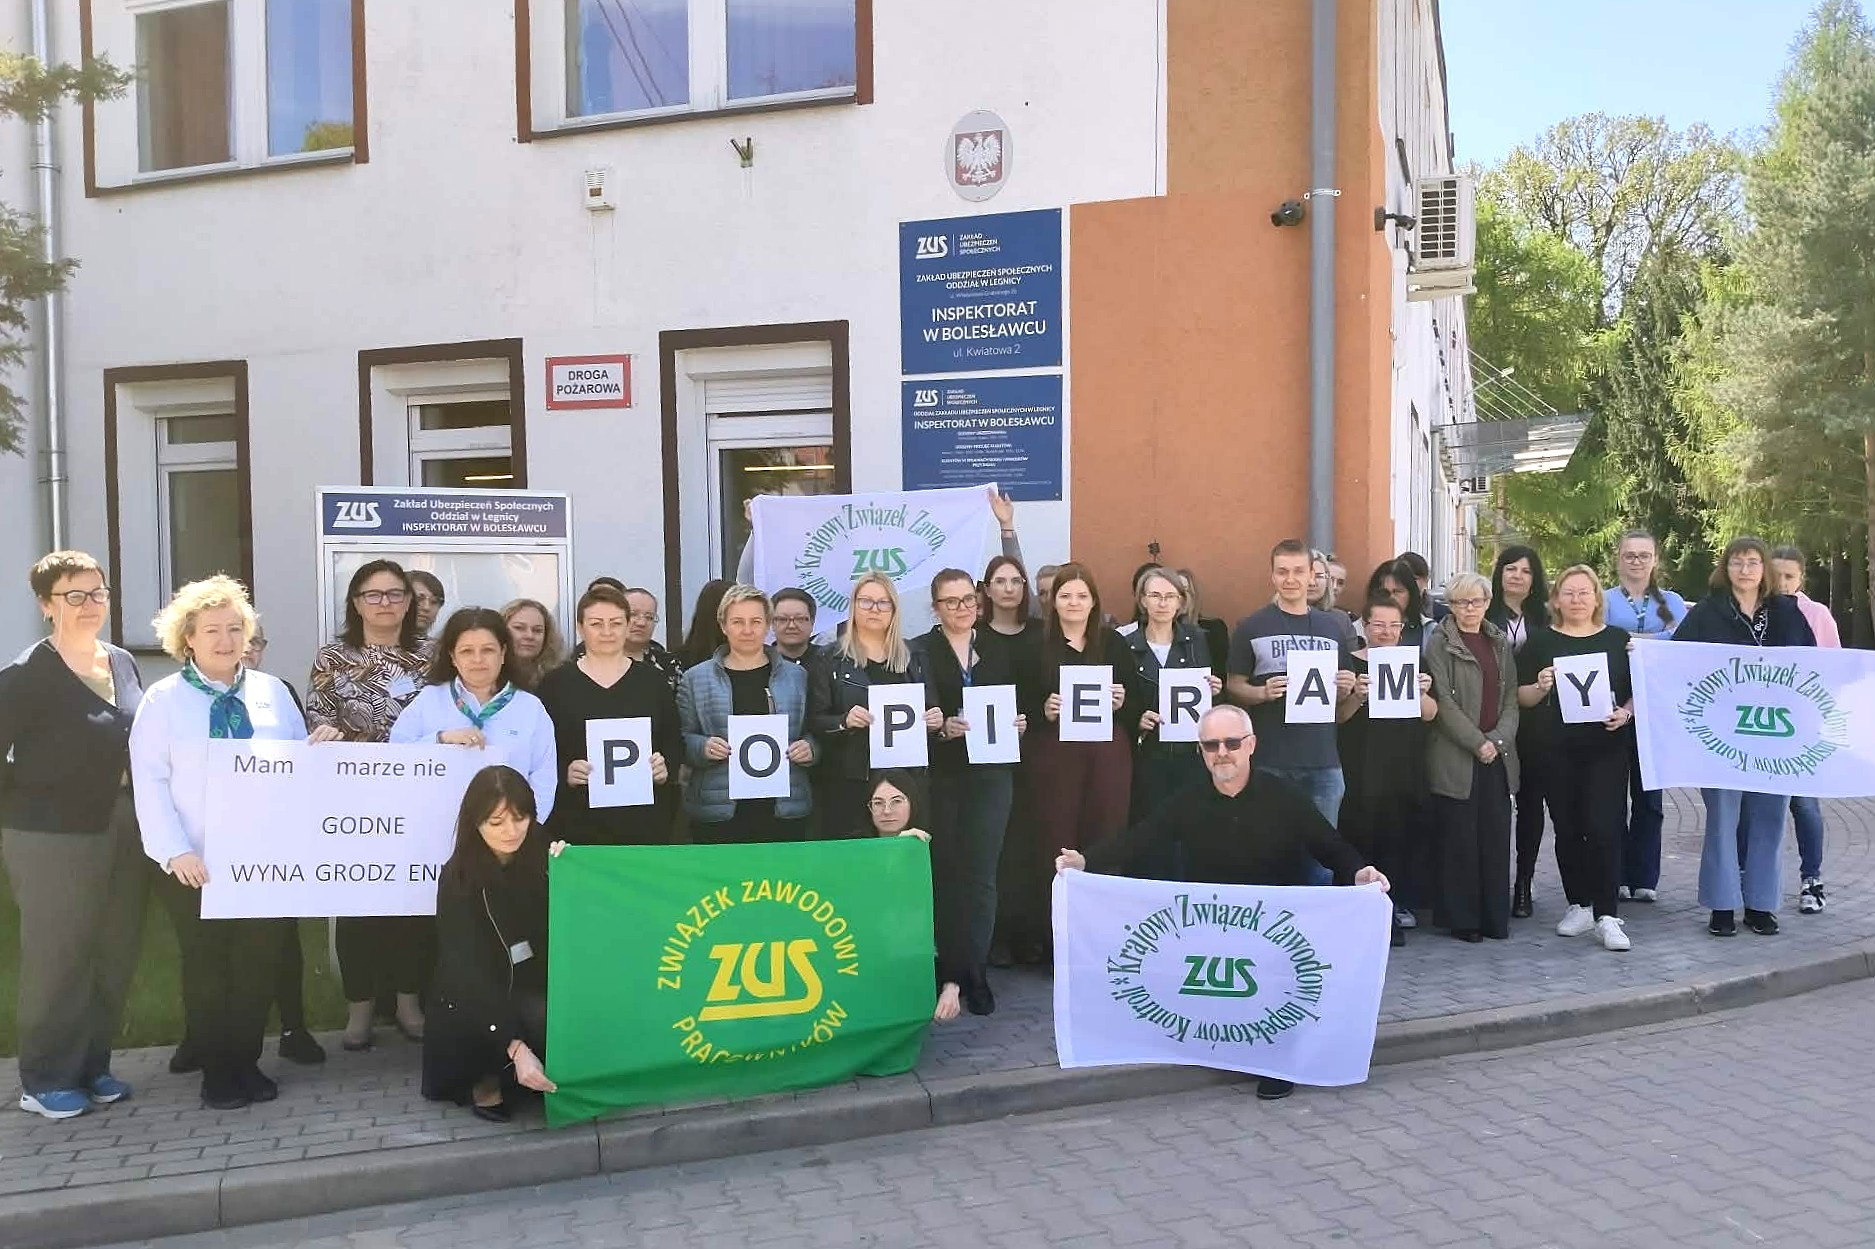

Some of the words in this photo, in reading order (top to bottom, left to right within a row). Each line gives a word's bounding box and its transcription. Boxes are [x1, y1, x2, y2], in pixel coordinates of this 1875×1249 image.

[916, 235, 948, 260] ZUS
[916, 273, 946, 282] ZAKŁAD
[946, 268, 996, 280] UBEZPIECZEŃ
[998, 264, 1052, 276] SPOŁECZNYCH
[946, 280, 980, 290] ODDZIAŁ
[980, 279, 989, 287] W
[990, 277, 1022, 286] LEGNICY
[932, 301, 1037, 322] INSPEKTORAT
[922, 328, 940, 342] W
[942, 320, 1046, 340] BOLESŁAWCU
[966, 346, 1012, 357] Kwiatowa
[1014, 344, 1022, 354] 2
[556, 382, 620, 395] POŻAROWA
[568, 370, 609, 380] DROGA
[914, 389, 938, 406] ZUS
[914, 419, 977, 430] INSPEKTORAT
[978, 418, 989, 428] W
[990, 416, 1054, 428] BOLESŁAWCU
[332, 501, 382, 528] ZUS
[394, 499, 427, 510] Zakład
[430, 500, 492, 510] Ubezpieczeń
[494, 500, 554, 512] Społecznych
[430, 511, 469, 521] Oddział
[482, 512, 519, 524] Legnicy
[842, 501, 907, 531] Związek
[402, 522, 468, 532] INSPEKTORAT
[470, 524, 481, 532] W
[483, 524, 547, 533] BOLESŁAWCU
[794, 514, 848, 570] Krajowy
[908, 510, 946, 548] Zawo
[850, 548, 908, 580] ZUS
[799, 576, 850, 612] ontroli
[1729, 656, 1800, 688] Związek
[1677, 667, 1733, 718] Krajowy
[602, 738, 640, 786] P
[738, 733, 782, 778] O
[883, 704, 916, 748] P
[986, 704, 997, 744] I
[1072, 683, 1102, 723] E
[1170, 685, 1200, 724] R
[1294, 668, 1330, 706] A
[1377, 663, 1416, 701] M
[1564, 670, 1600, 708] Y
[1734, 705, 1796, 738] ZUS
[1685, 725, 1748, 772] Kontroli
[1754, 740, 1850, 780] Inspektorów
[234, 754, 294, 774] Mam
[336, 760, 405, 776] marze
[414, 758, 447, 776] nie
[322, 816, 406, 835] GODNE
[231, 864, 305, 882] WYNA
[315, 864, 396, 882] GRODZ
[408, 864, 446, 882] EN
[1174, 893, 1266, 932] Związek
[657, 886, 735, 990] ZWIĄZEK
[742, 879, 859, 976] ZAWODOWY
[1106, 906, 1181, 975] Krajowy
[1262, 910, 1332, 1005] Zawodowy
[698, 938, 823, 1022] ZUS
[1178, 955, 1258, 998] ZUS
[1111, 985, 1192, 1043] Kontroli
[1193, 1000, 1322, 1052] Inspektorów
